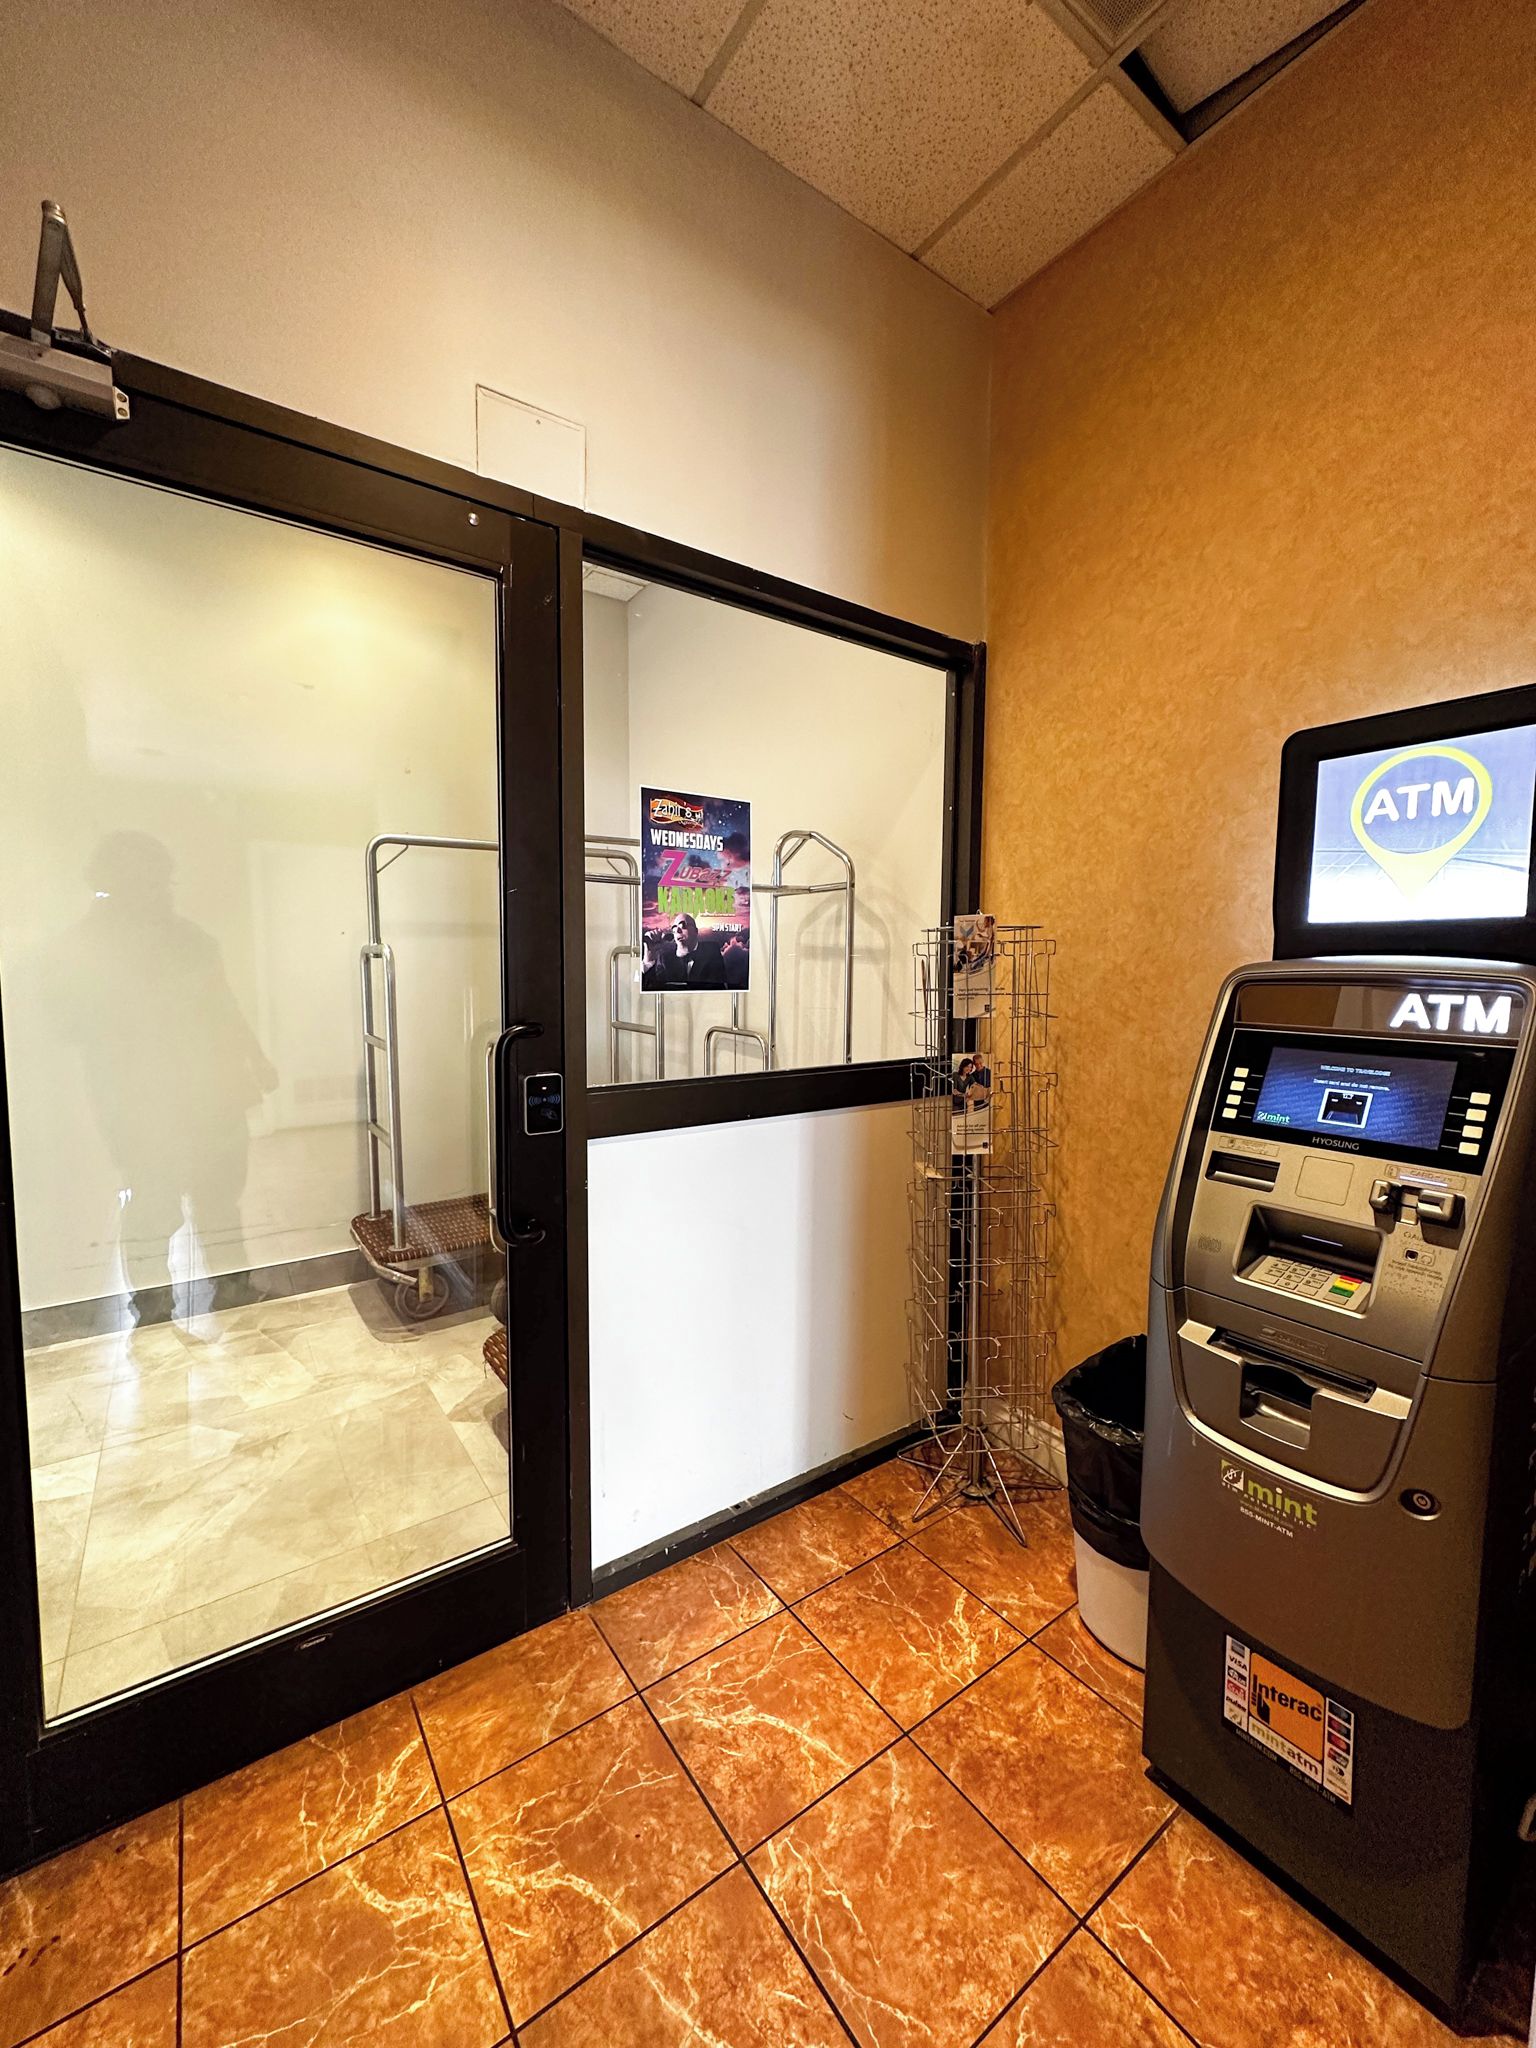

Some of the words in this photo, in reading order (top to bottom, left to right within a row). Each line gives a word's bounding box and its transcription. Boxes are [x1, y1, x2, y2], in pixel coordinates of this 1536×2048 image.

[1363, 776, 1475, 824] ATM
[650, 828, 724, 851] WEDNESDAYS
[657, 886, 736, 915] KARAOKE
[1390, 992, 1512, 1034] ATM
[1267, 1113, 1290, 1123] mint
[1312, 1136, 1360, 1150] HYOSUNG
[1247, 1480, 1317, 1526] mint
[1228, 1655, 1248, 1672] VISA
[1253, 1674, 1322, 1722] Interac
